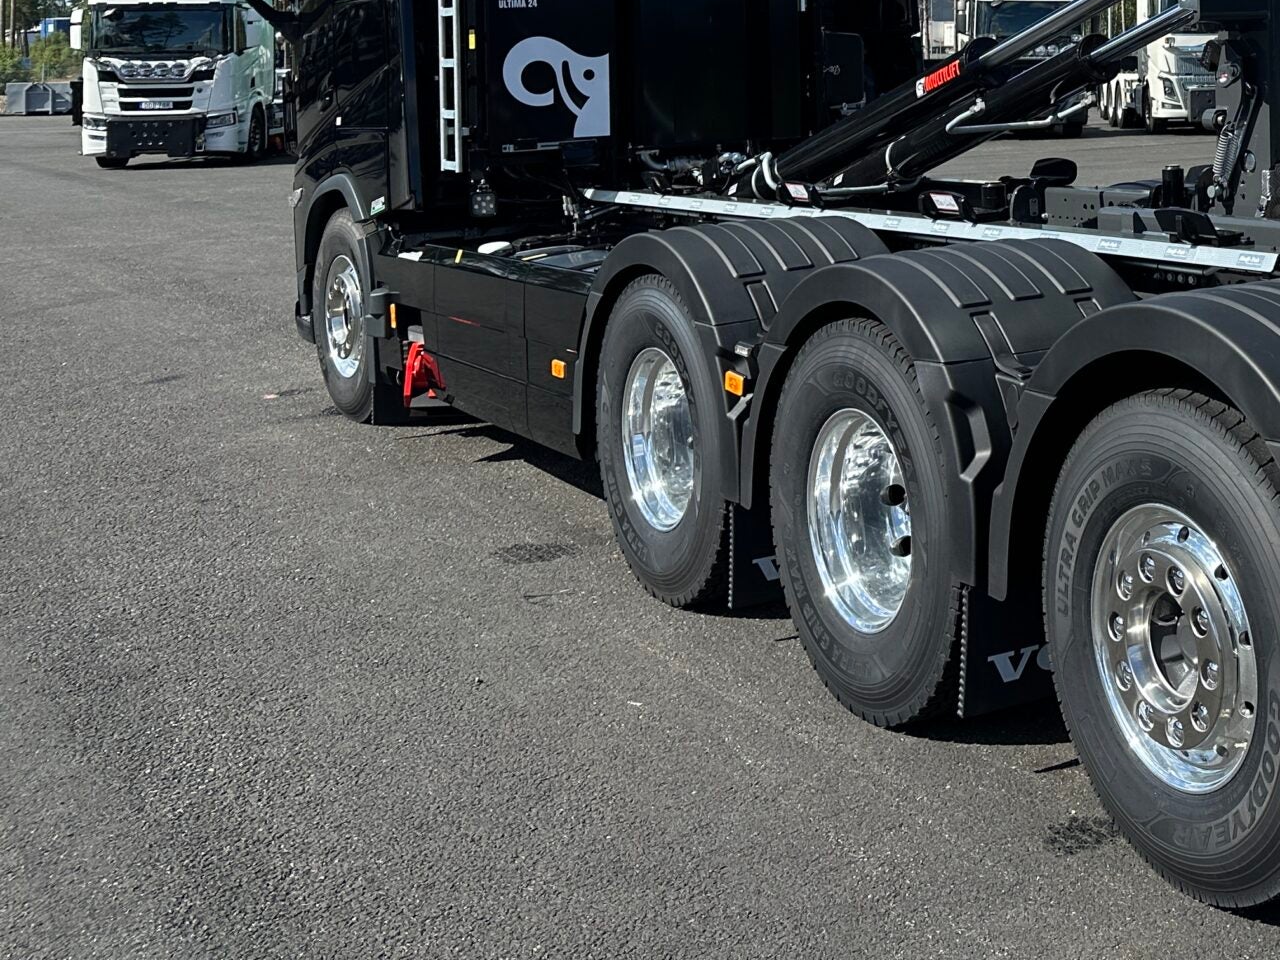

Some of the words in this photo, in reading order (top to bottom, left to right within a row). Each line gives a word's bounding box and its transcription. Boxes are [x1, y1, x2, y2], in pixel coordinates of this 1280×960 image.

[498, 0, 526, 9] ULTIMA
[528, 0, 538, 8] 24
[925, 60, 960, 92] MULTILIFT
[1057, 530, 1078, 617] ULTRA
[1071, 479, 1101, 529] GRIP
[1101, 455, 1137, 489] MAX
